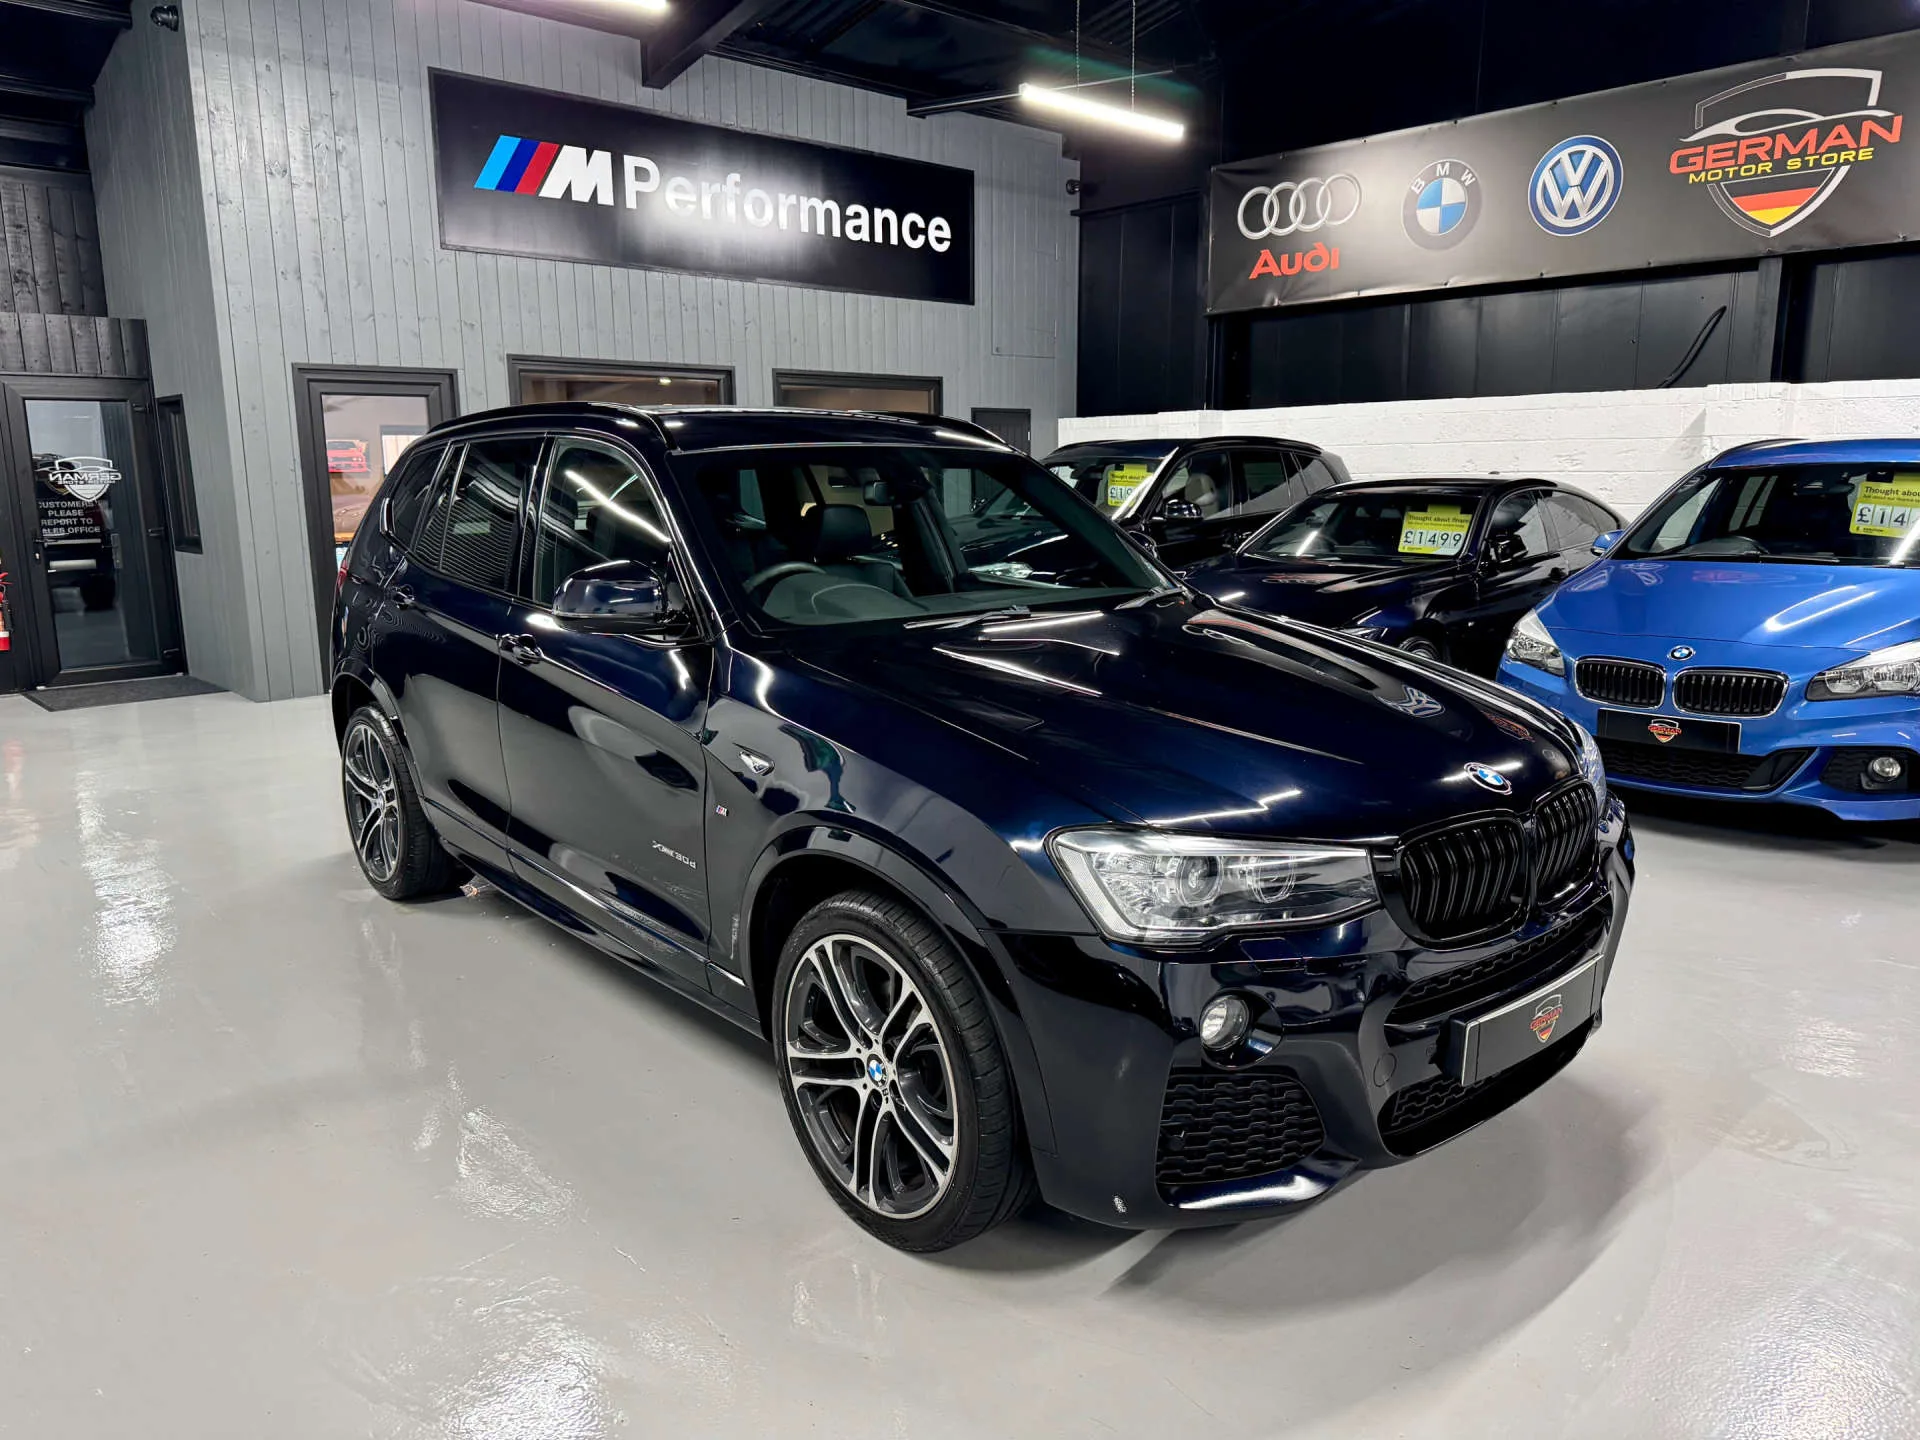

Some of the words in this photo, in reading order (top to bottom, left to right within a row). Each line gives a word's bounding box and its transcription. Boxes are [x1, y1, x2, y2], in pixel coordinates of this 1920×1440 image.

[1669, 115, 1902, 174] GERMAN
[1688, 161, 1773, 184] MOTOR
[1786, 147, 1875, 171] STORE
[1411, 162, 1476, 195] BMW
[623, 154, 952, 253] Performance
[1249, 241, 1339, 280] Audi
[1110, 487, 1133, 499] £19
[1864, 486, 1899, 497] Thought
[40, 518, 78, 526] REPORT
[1856, 506, 1908, 526] £14
[67, 526, 101, 534] OFFICE
[1403, 530, 1462, 547] £1499
